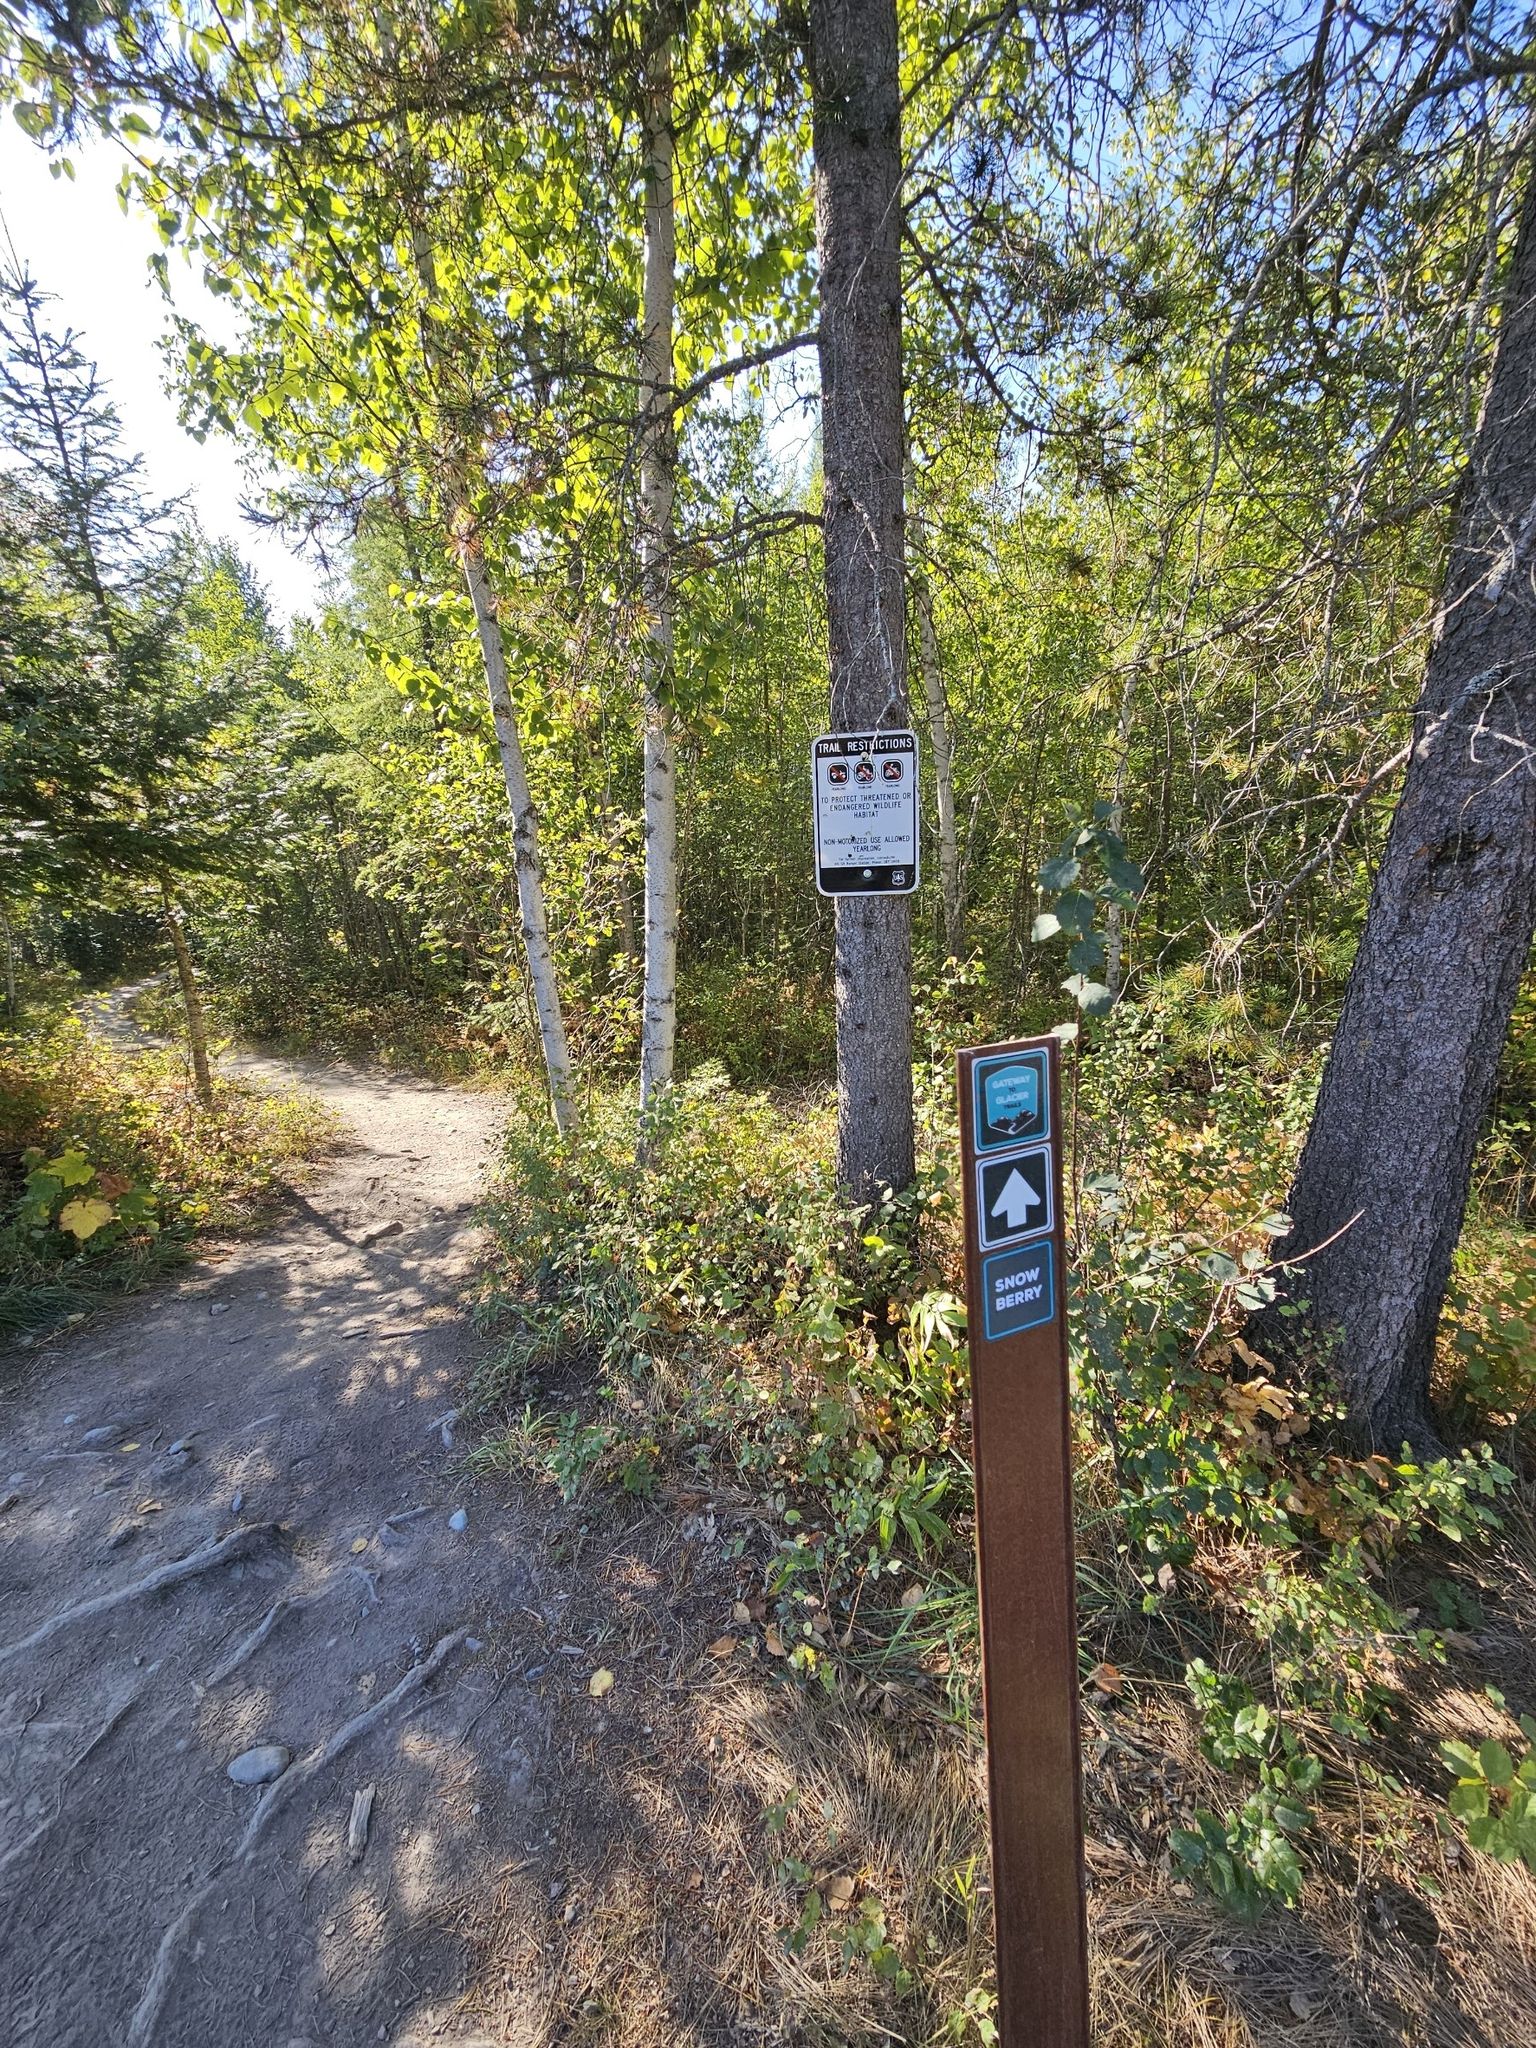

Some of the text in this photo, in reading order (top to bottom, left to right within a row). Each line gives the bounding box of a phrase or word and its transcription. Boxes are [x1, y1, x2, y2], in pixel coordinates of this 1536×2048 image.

[818, 738, 912, 754] TRAIL RESTRICTIONS
[831, 795, 857, 803] PROTECT
[860, 793, 900, 801] THREATENED
[902, 792, 911, 800] OR
[829, 801, 902, 812] ENDANGERED WILDLIFE
[823, 835, 911, 846] NON-MOTORIZED USE ALLOWED
[992, 1075, 1031, 1089] GATEWAY
[995, 1091, 1030, 1105] GLACIER
[995, 1267, 1040, 1292] SNOW
[996, 1284, 1042, 1311] BERRY
